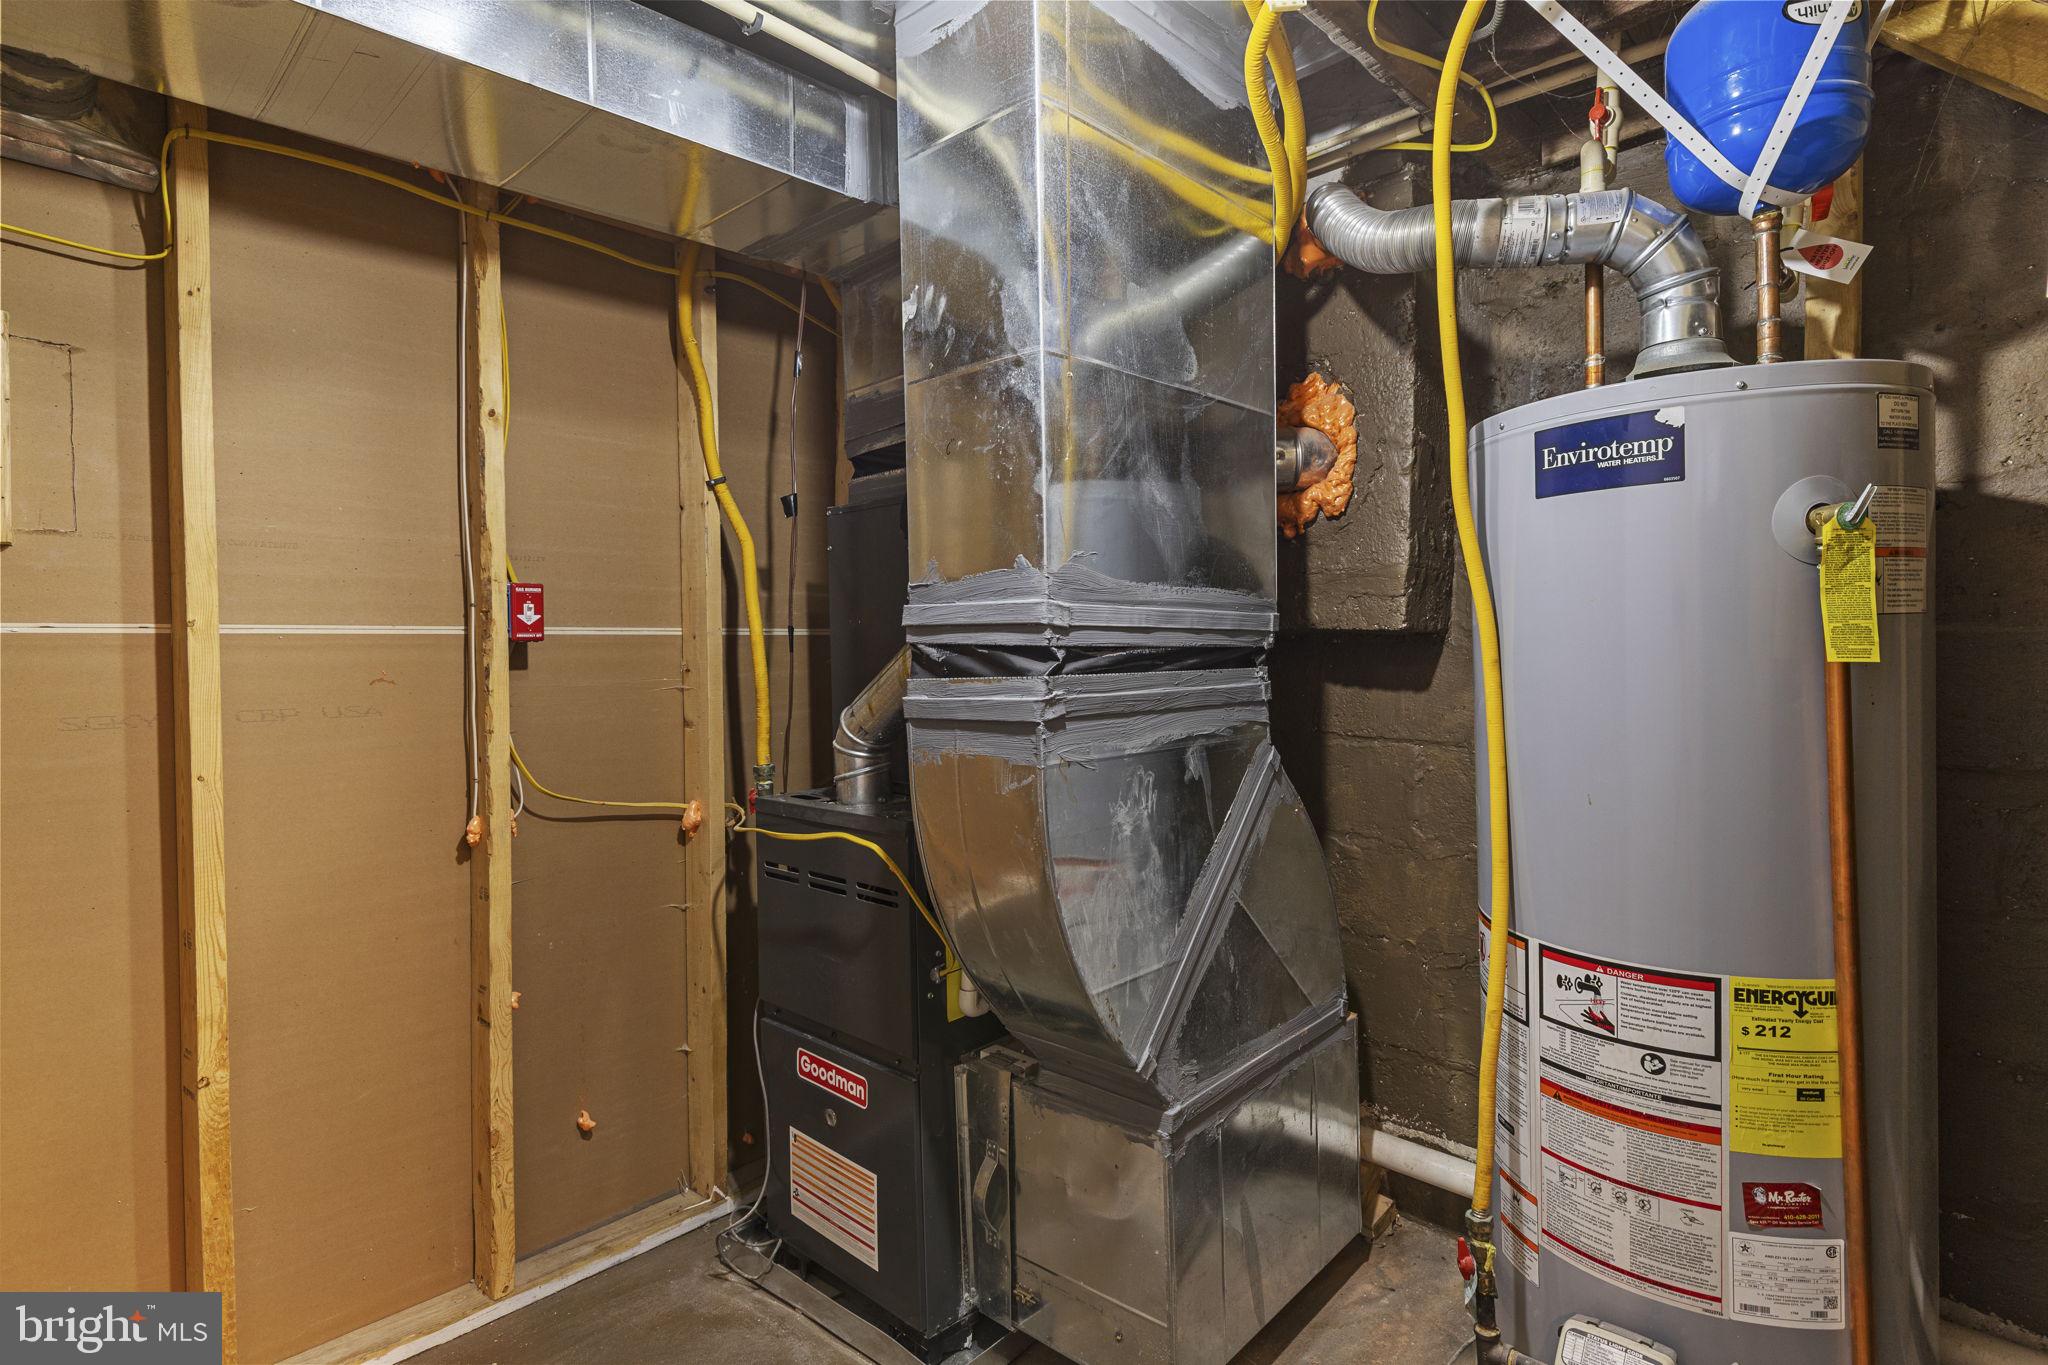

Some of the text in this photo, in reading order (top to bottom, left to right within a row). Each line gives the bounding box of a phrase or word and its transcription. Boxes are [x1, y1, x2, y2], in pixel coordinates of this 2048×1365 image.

[1542, 437, 1673, 470] Envirotemp
[1598, 459, 1621, 468] WATER
[1606, 968, 1644, 981] DANGER
[1734, 988, 1837, 1010] ENERGYGUI
[1741, 1025, 1791, 1038] $ 212
[800, 1054, 865, 1101] Goodman
[1769, 1191, 1812, 1204] Mr. Rooter
